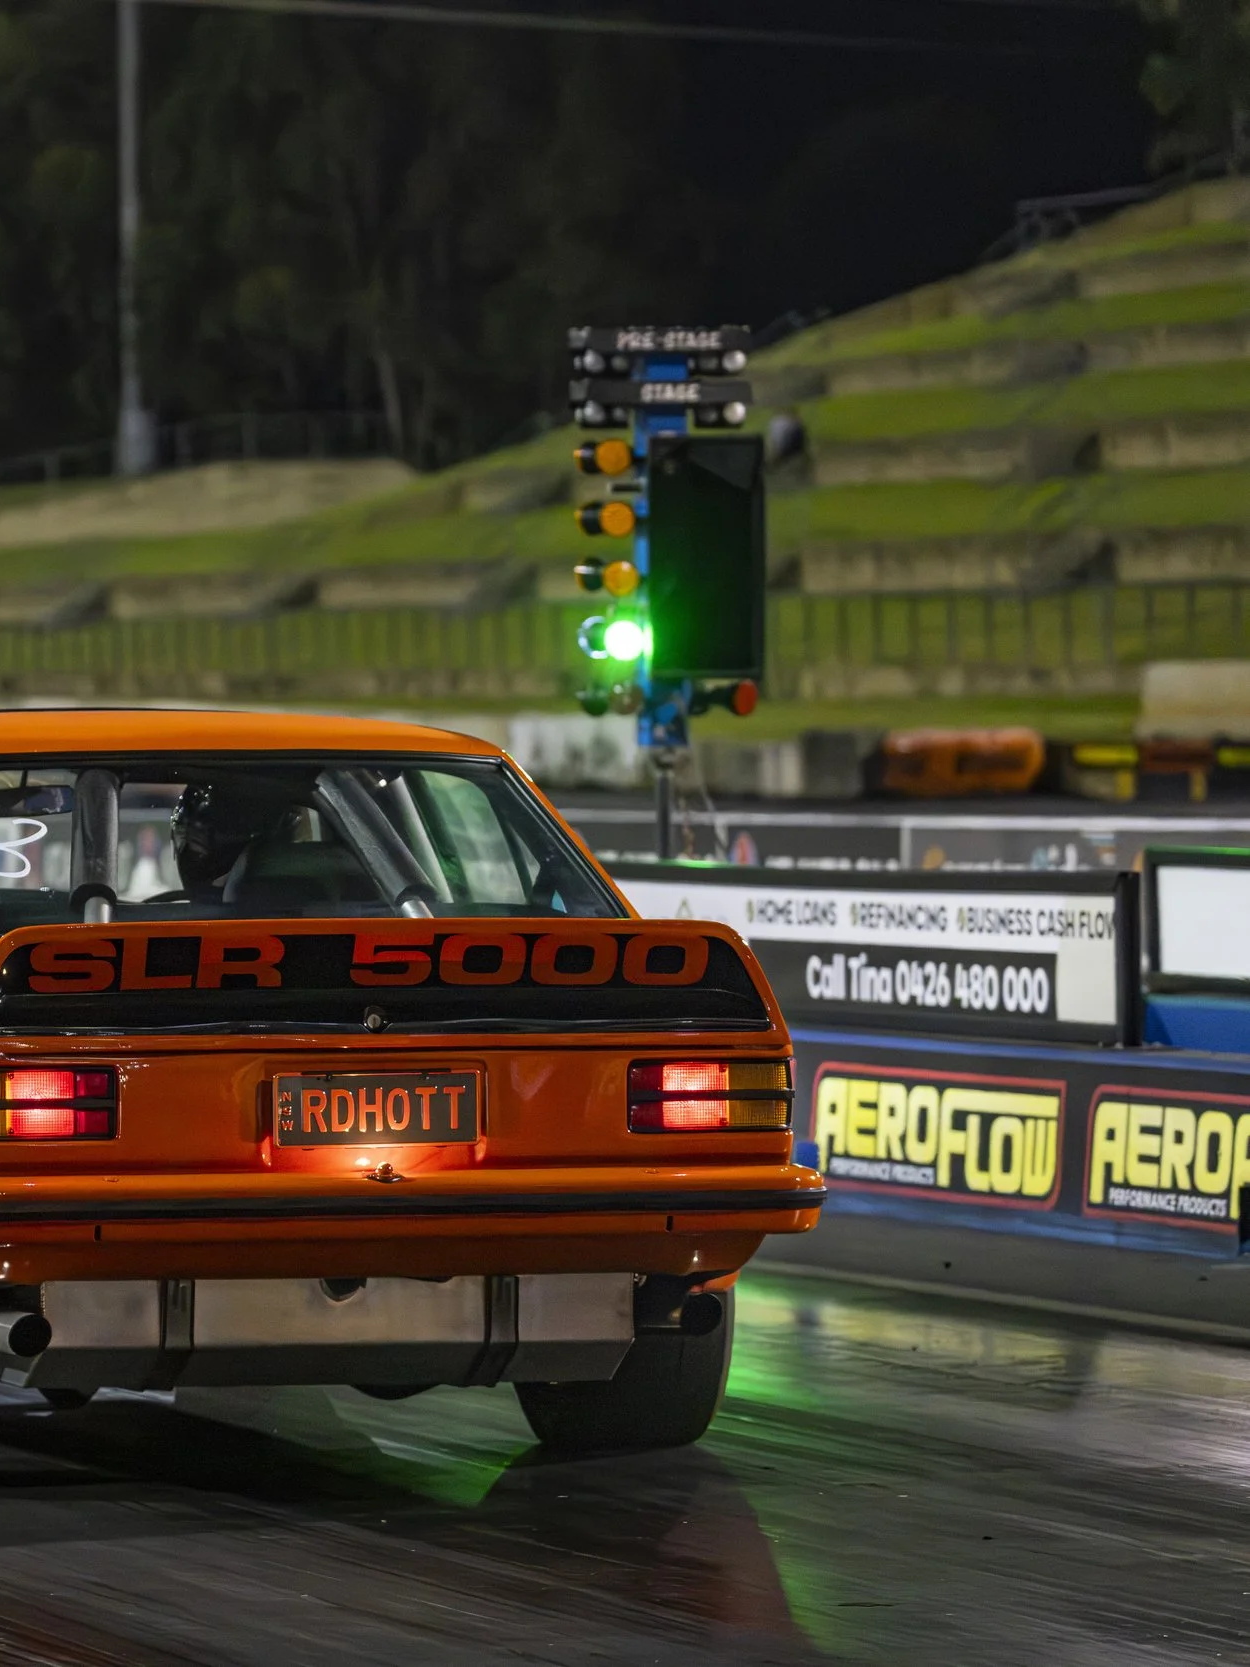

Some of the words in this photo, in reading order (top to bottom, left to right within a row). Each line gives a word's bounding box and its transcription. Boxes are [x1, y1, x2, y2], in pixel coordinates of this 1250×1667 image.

[640, 383, 700, 400] STAGE
[756, 899, 792, 926] HOME
[797, 899, 837, 927] LOANS
[860, 902, 948, 932] REFINANCING
[967, 907, 1033, 936] BUSINESS
[1037, 909, 1076, 938] CASH
[29, 934, 282, 993] SLR
[350, 931, 709, 987] 5000
[806, 954, 846, 1000] Call
[848, 952, 893, 1003] Tina
[895, 959, 951, 1007] 0426
[954, 963, 999, 1010] 480
[1002, 965, 1049, 1013] 000
[302, 1086, 466, 1133] RDHOTT
[814, 1077, 1058, 1196] AEROFLOW
[1108, 1187, 1176, 1211] PERFORMANCE
[1177, 1194, 1228, 1217] PRODUCTS
